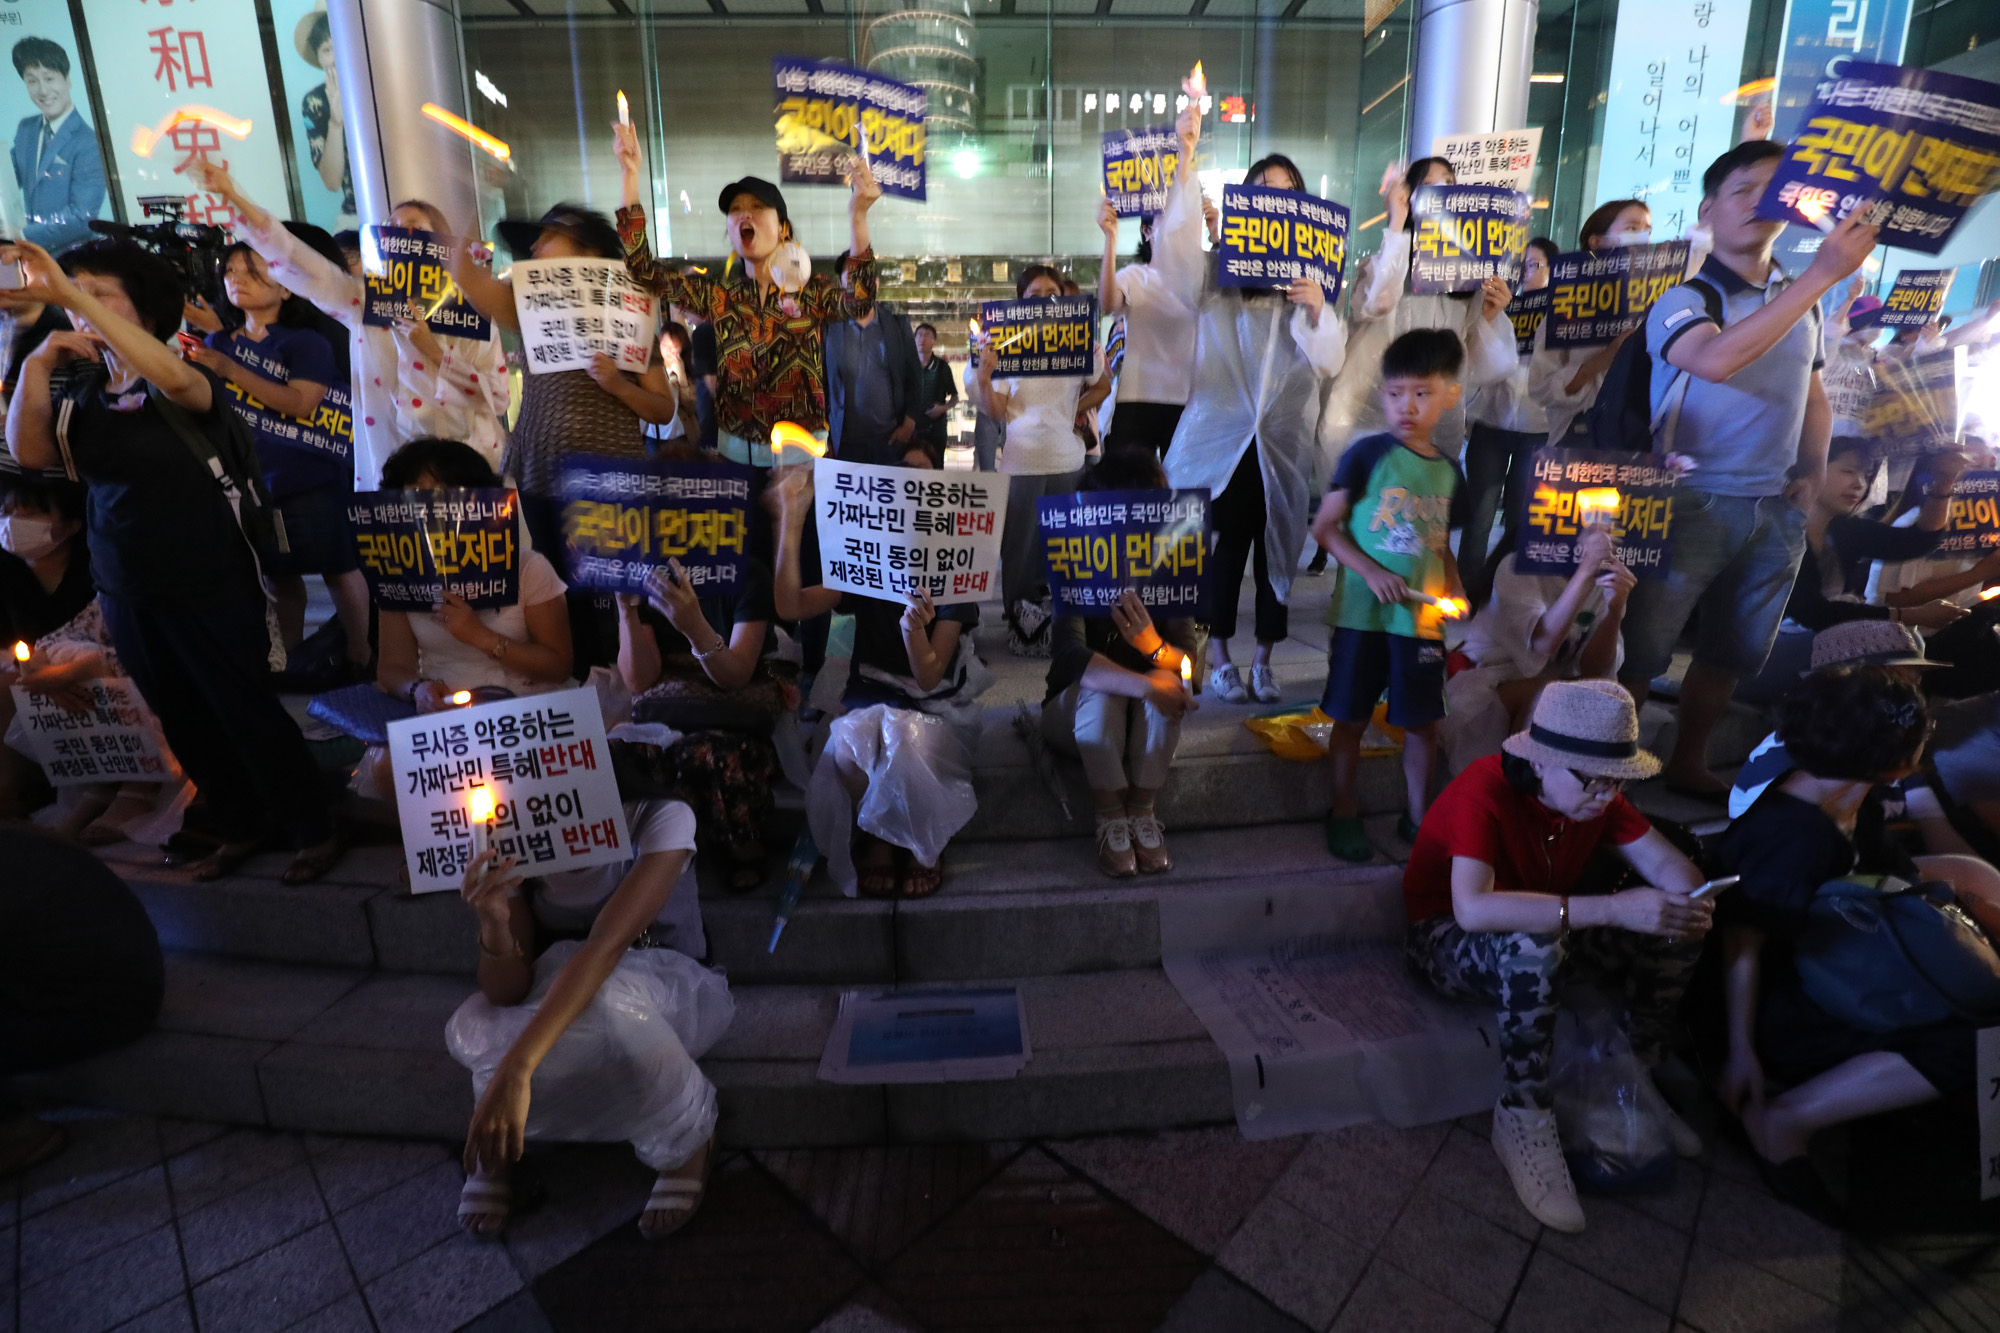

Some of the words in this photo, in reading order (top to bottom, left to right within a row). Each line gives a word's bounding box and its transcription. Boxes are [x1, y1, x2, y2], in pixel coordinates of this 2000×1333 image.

[1683, 45, 1709, 99] 나의
[1636, 61, 1669, 168] 일어나서
[1444, 141, 1481, 159] 무사증
[1485, 136, 1529, 155] 악용하는
[1672, 115, 1698, 193] 어여쁜
[1791, 115, 1915, 191] 국민이
[1106, 155, 1158, 192] 국민이
[1450, 158, 1485, 176] 짜난민
[1225, 193, 1250, 210] 나는
[1252, 194, 1298, 216] 대한민국
[1299, 200, 1347, 232] 국민입니다
[1446, 194, 1490, 213] 대한민국
[1418, 217, 1482, 258] 국민이
[1487, 218, 1529, 262] 먼저다
[1664, 209, 1686, 241] 자
[380, 236, 423, 257] 대한민국
[1223, 216, 1290, 256] 국민이
[1294, 222, 1345, 273] 먼저다
[1226, 259, 1264, 277] 국민은
[1266, 260, 1302, 279] 안전을
[1421, 262, 1457, 281] 국민은
[1460, 261, 1494, 281] 안전을
[1553, 261, 1578, 280] 나는
[1581, 254, 1631, 277] 대한민국
[986, 306, 1004, 322] 나는
[1006, 304, 1043, 320] 대한민국
[1045, 302, 1090, 318] 국민입니다
[1552, 279, 1622, 320] 국민이
[1886, 288, 1930, 312] 국민이
[431, 309, 480, 330] 원합니다
[1556, 322, 1592, 339] 국민은
[989, 323, 1038, 355] 국민이
[1042, 321, 1090, 353] 먼저다
[235, 345, 260, 367] 나는
[1022, 356, 1049, 371] 안전을
[1051, 355, 1086, 370] 원합니다
[261, 417, 299, 440] 안전을
[302, 429, 348, 458] 원합니다
[296, 405, 354, 443] 저다
[666, 475, 750, 500] 국민입니다
[1534, 459, 1564, 482] 나는
[1566, 460, 1617, 484] 대한민국
[835, 472, 896, 504] 무사증
[904, 480, 989, 509] 악용하는
[347, 504, 372, 525] 나는
[374, 501, 429, 523] 대한민국
[432, 500, 513, 522] 국민입니다
[827, 500, 905, 534] 가짜난민
[1041, 508, 1067, 530] 나는
[1070, 503, 1128, 527] 대한민국
[1131, 500, 1206, 524] 국민입니다
[1945, 497, 2000, 532] 민이
[655, 507, 748, 557] 먼저다
[356, 531, 424, 577] 국민이
[429, 528, 514, 576] 먼저다
[844, 537, 881, 566] 국민
[887, 545, 929, 572] 동의
[936, 546, 975, 573] 없이
[1047, 532, 1118, 580] 국민이
[1125, 531, 1206, 577] 먼저다
[450, 578, 508, 601] 원합니다
[829, 559, 884, 590] 제정된
[889, 570, 947, 598] 난민법
[953, 571, 989, 595] 반대
[1060, 586, 1096, 606] 국민은
[1141, 585, 1199, 606] 원합니다
[54, 737, 90, 757] 국민
[90, 735, 121, 755] 동의
[119, 735, 145, 754] 없이
[411, 724, 469, 763] 무사증
[474, 708, 575, 750] 악용하는
[49, 757, 99, 778] 제정된
[99, 755, 139, 775] 난민법
[407, 757, 485, 798] 가짜난민
[430, 807, 470, 841] 국민
[486, 799, 521, 836] 의
[526, 788, 584, 828] 없이
[561, 818, 619, 857] 반대
